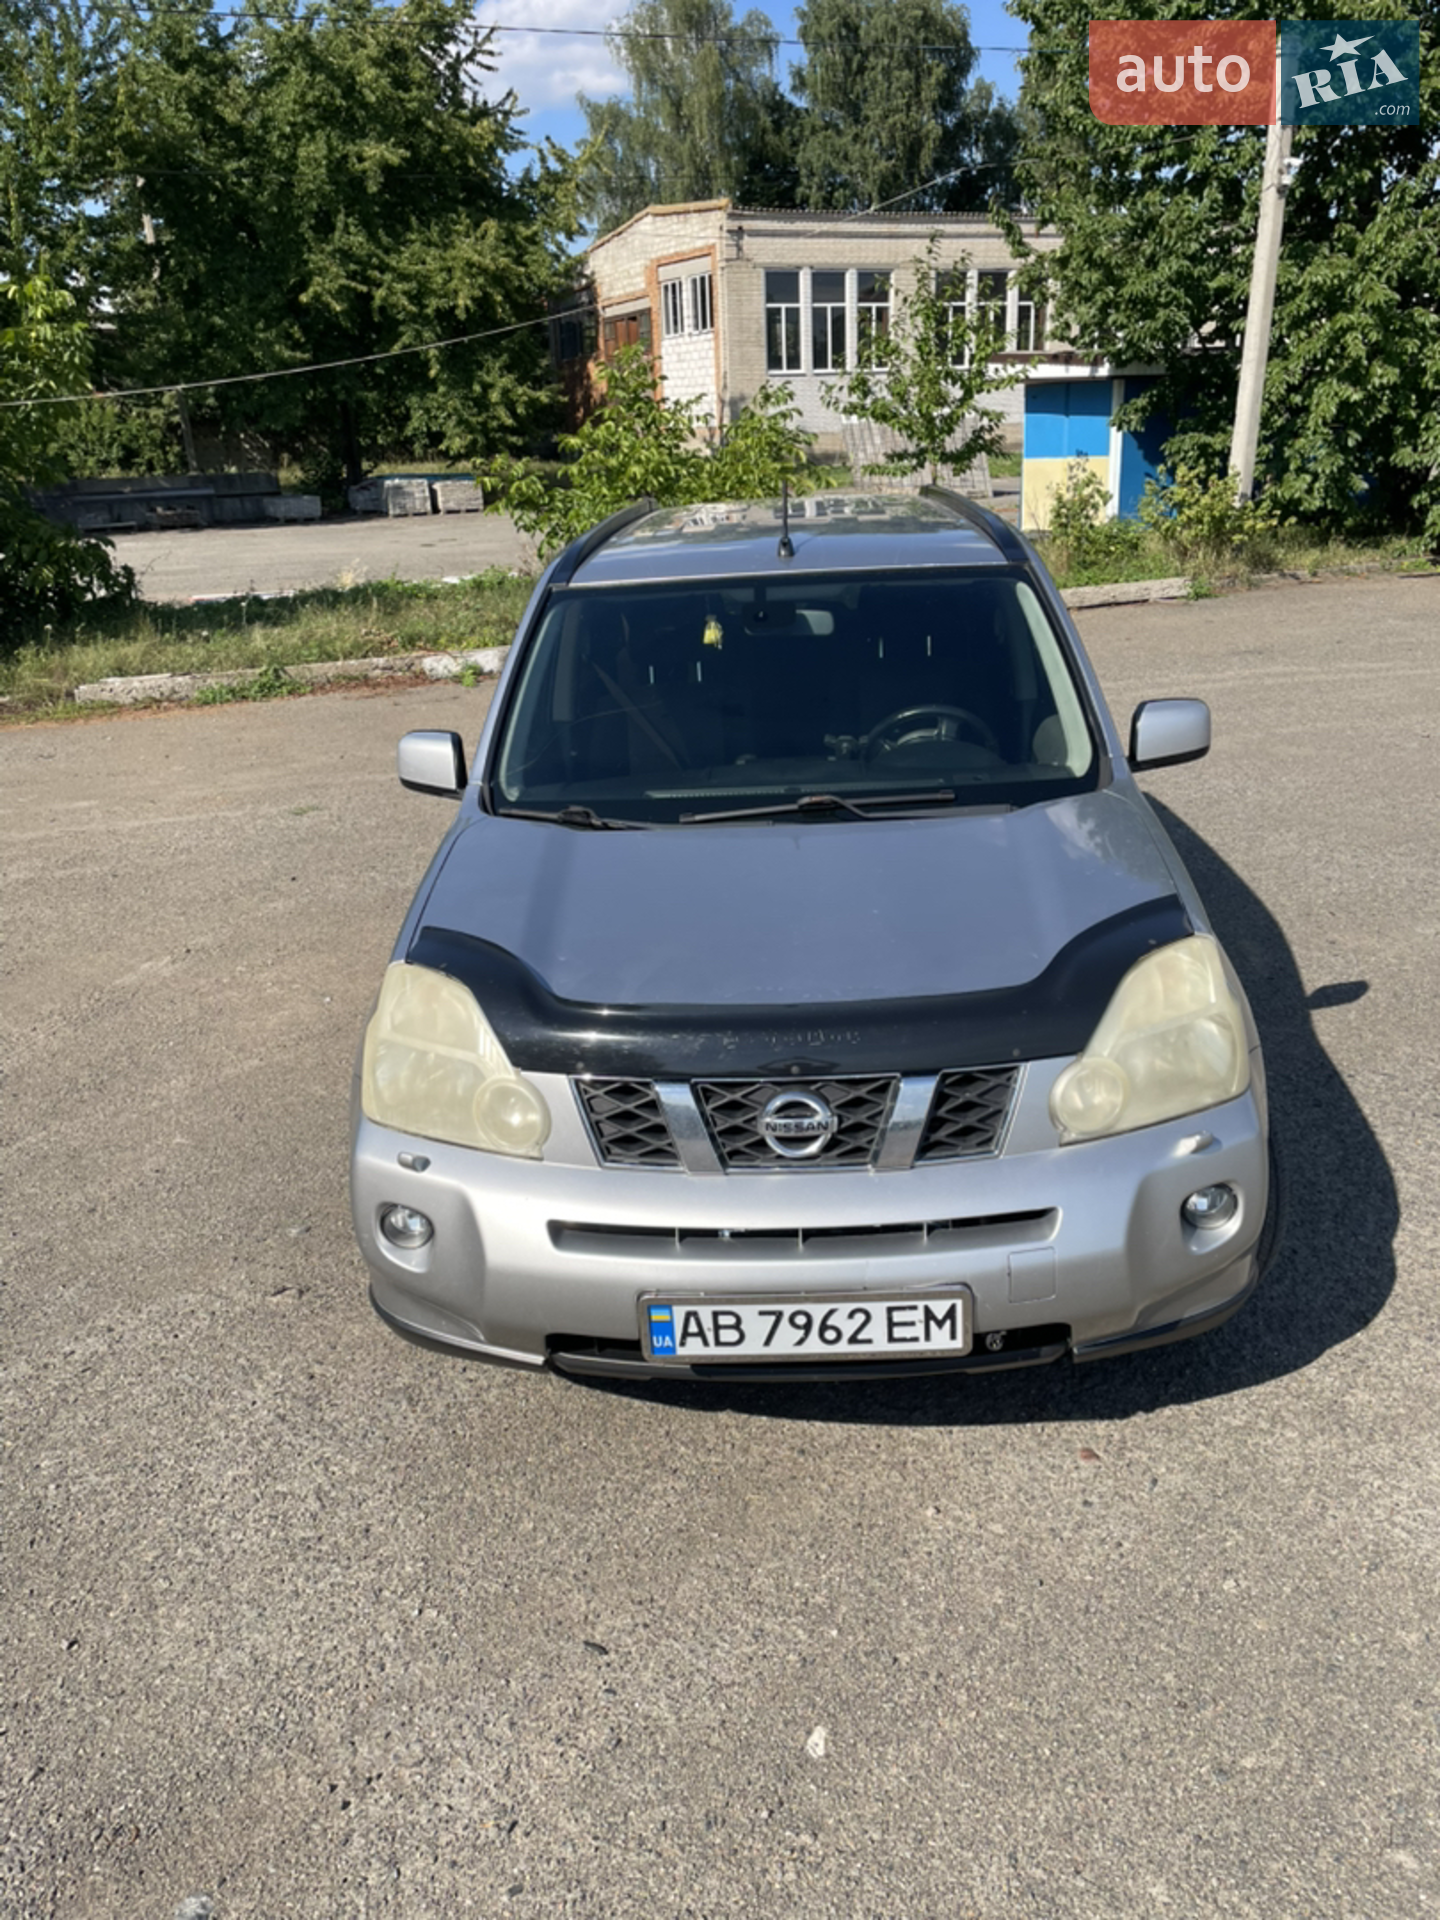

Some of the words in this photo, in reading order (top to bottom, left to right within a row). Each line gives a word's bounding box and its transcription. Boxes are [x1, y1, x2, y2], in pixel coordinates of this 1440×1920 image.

[765, 1120, 830, 1133] NISSAN
[679, 1310, 746, 1348] AB
[758, 1307, 874, 1348] 7962
[886, 1302, 958, 1344] EM
[652, 1335, 674, 1348] UA
